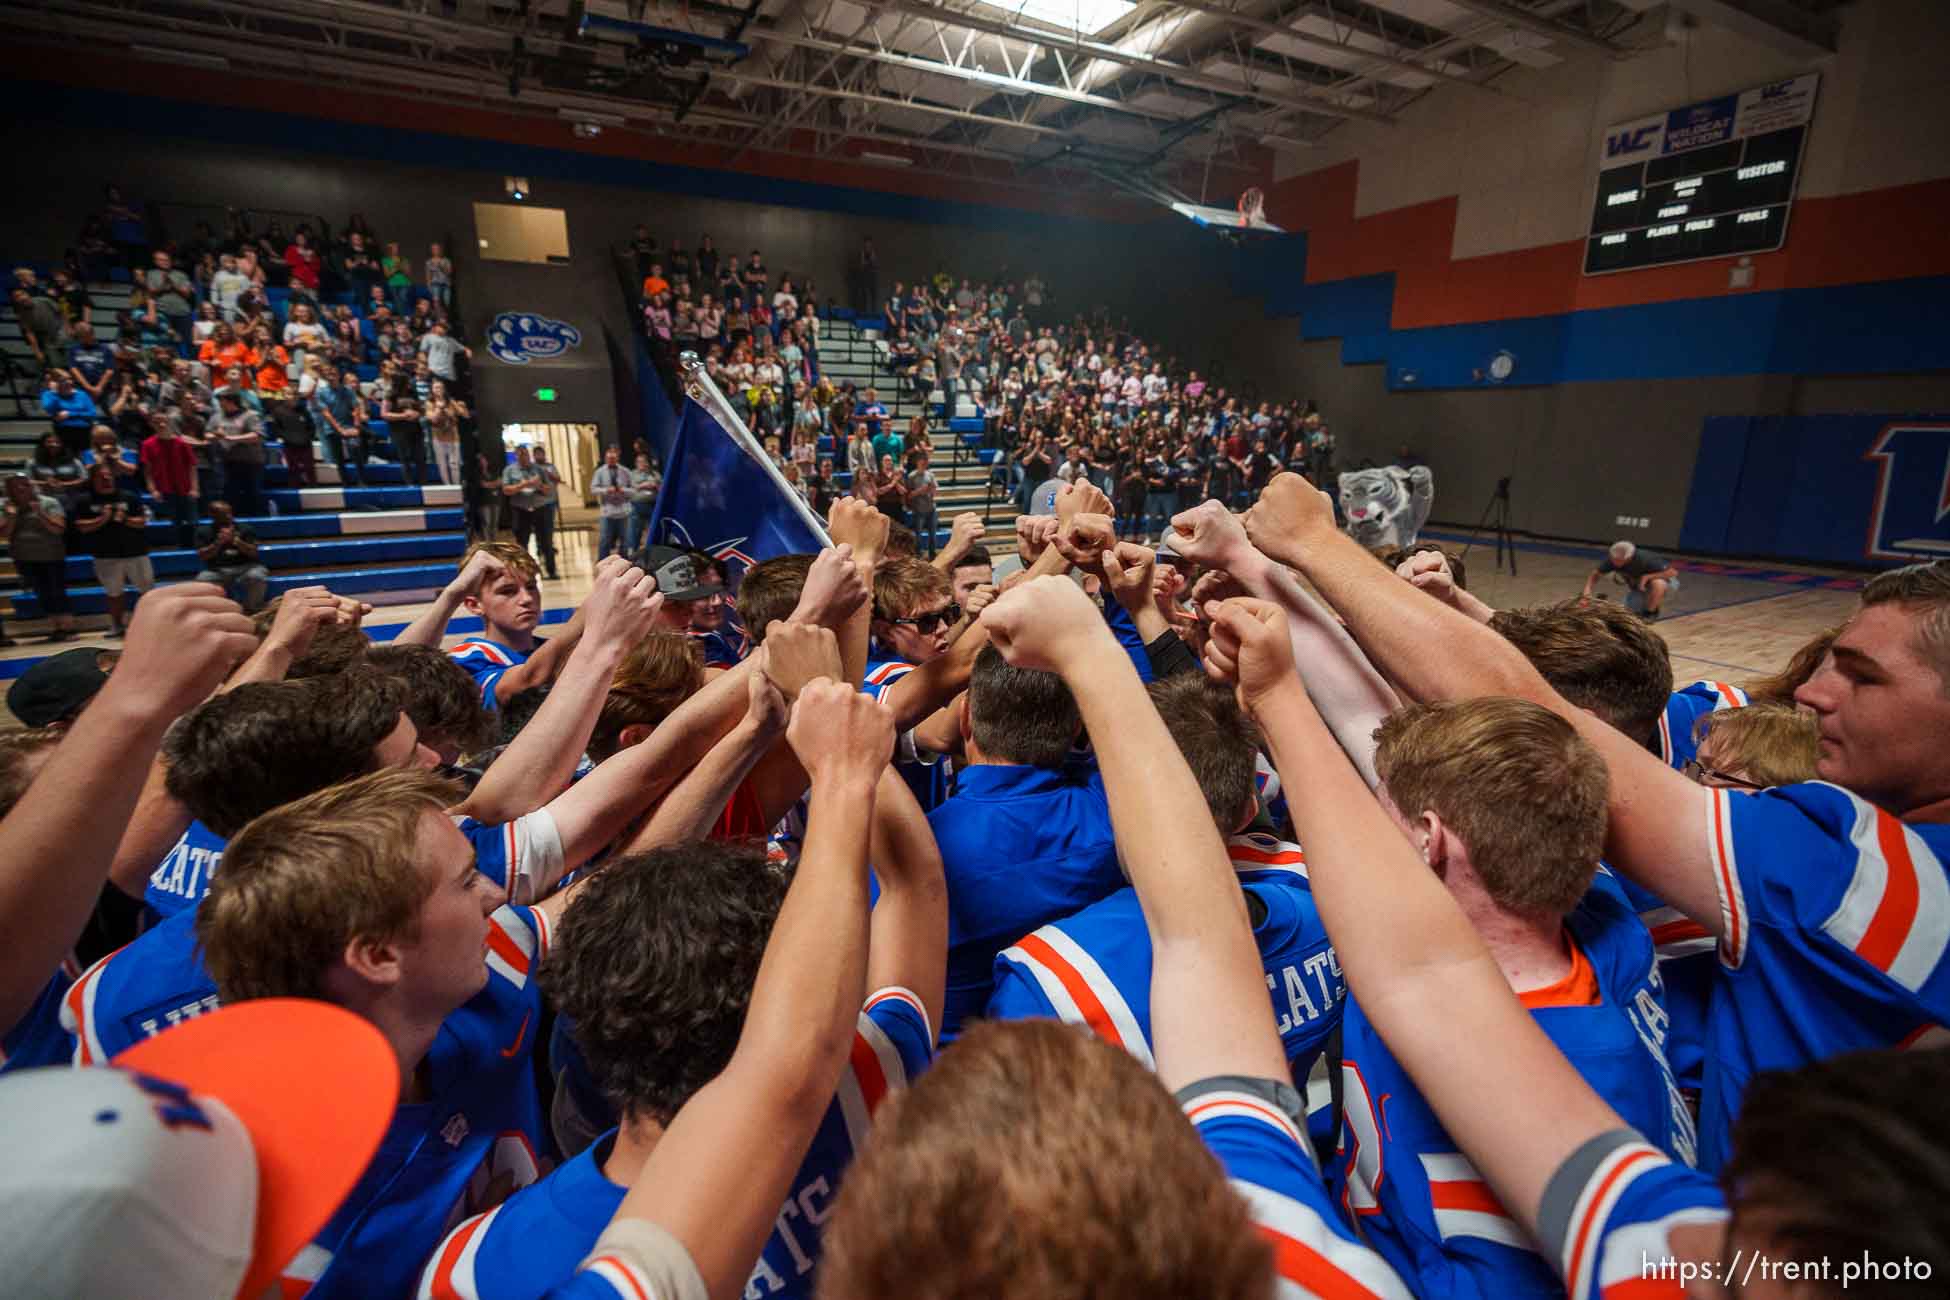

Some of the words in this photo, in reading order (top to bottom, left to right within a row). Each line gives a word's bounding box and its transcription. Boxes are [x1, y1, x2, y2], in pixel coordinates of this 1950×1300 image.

[1606, 125, 1664, 157] WC
[1737, 160, 1785, 180] VISITOR
[1737, 209, 1769, 223] FOULS
[1646, 223, 1679, 238] PLAYER
[1684, 218, 1715, 232] FOULS
